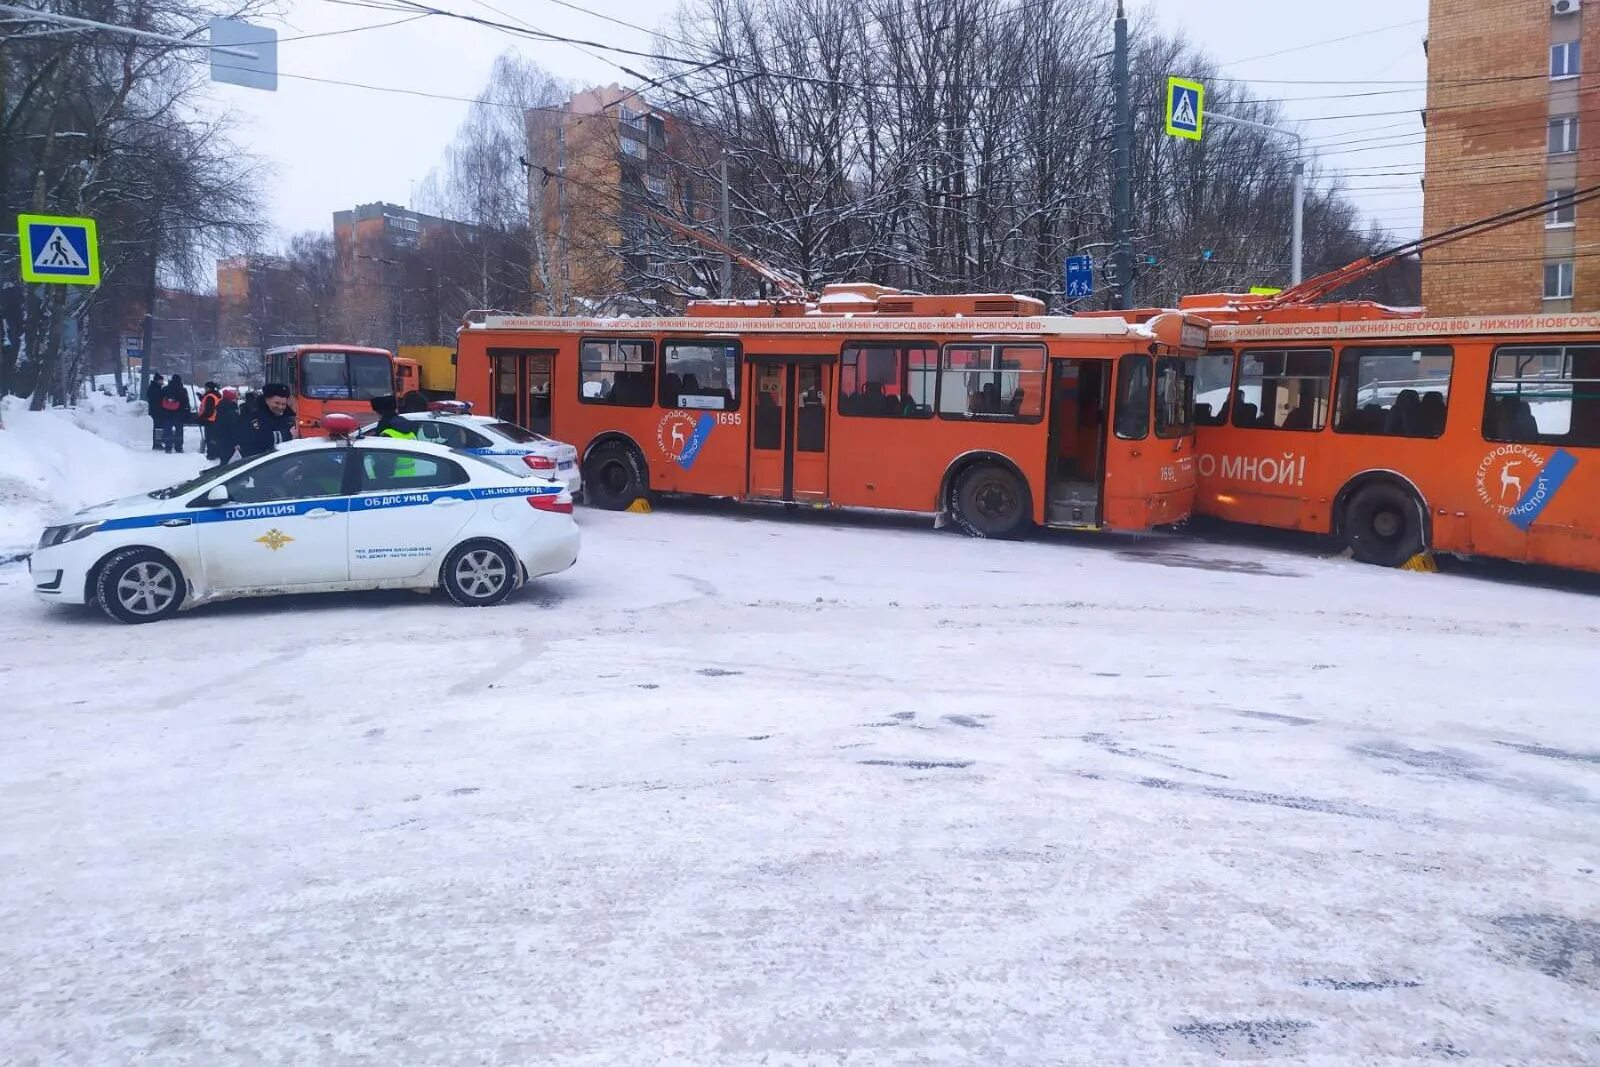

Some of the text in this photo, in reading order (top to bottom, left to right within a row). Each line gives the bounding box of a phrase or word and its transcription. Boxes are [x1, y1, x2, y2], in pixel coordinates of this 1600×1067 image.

[742, 321, 774, 330] НИЖНИЙ
[776, 321, 816, 331] НОВГОРОД
[817, 322, 831, 330] 800
[836, 321, 872, 331] НИЖНИЙ
[873, 322, 916, 331] НОВГОРОД
[917, 322, 932, 331] 800
[937, 322, 974, 331] НИЖНИЙ
[976, 322, 1024, 332] НОВГОРОД
[1025, 323, 1042, 332] 800
[1235, 325, 1271, 338] НИЖНИЙ
[1272, 324, 1321, 337] НОВГОРОД
[1321, 325, 1338, 336] 800
[1344, 321, 1389, 335] НИЖНИЙ
[1390, 321, 1448, 334] НОВГОРОД
[1450, 319, 1470, 331] 800
[1479, 316, 1534, 330] НИЖНИЙ
[1536, 315, 1600, 329] НОВГОРО
[681, 397, 687, 407] 9
[716, 413, 741, 425] 1695
[657, 410, 697, 453] НИЖЕГОРОДСКИЙ
[670, 434, 699, 461] ТРАНСПОРТ
[1220, 451, 1306, 487] МНОЙ!
[1476, 443, 1545, 504] НИЖЕГОРОДСКИЙ
[364, 493, 430, 507] ОБ ДПС УМВД
[1497, 477, 1550, 516] ТРАНСПОРТ
[225, 505, 297, 519] ПОЛИЦИЯ
